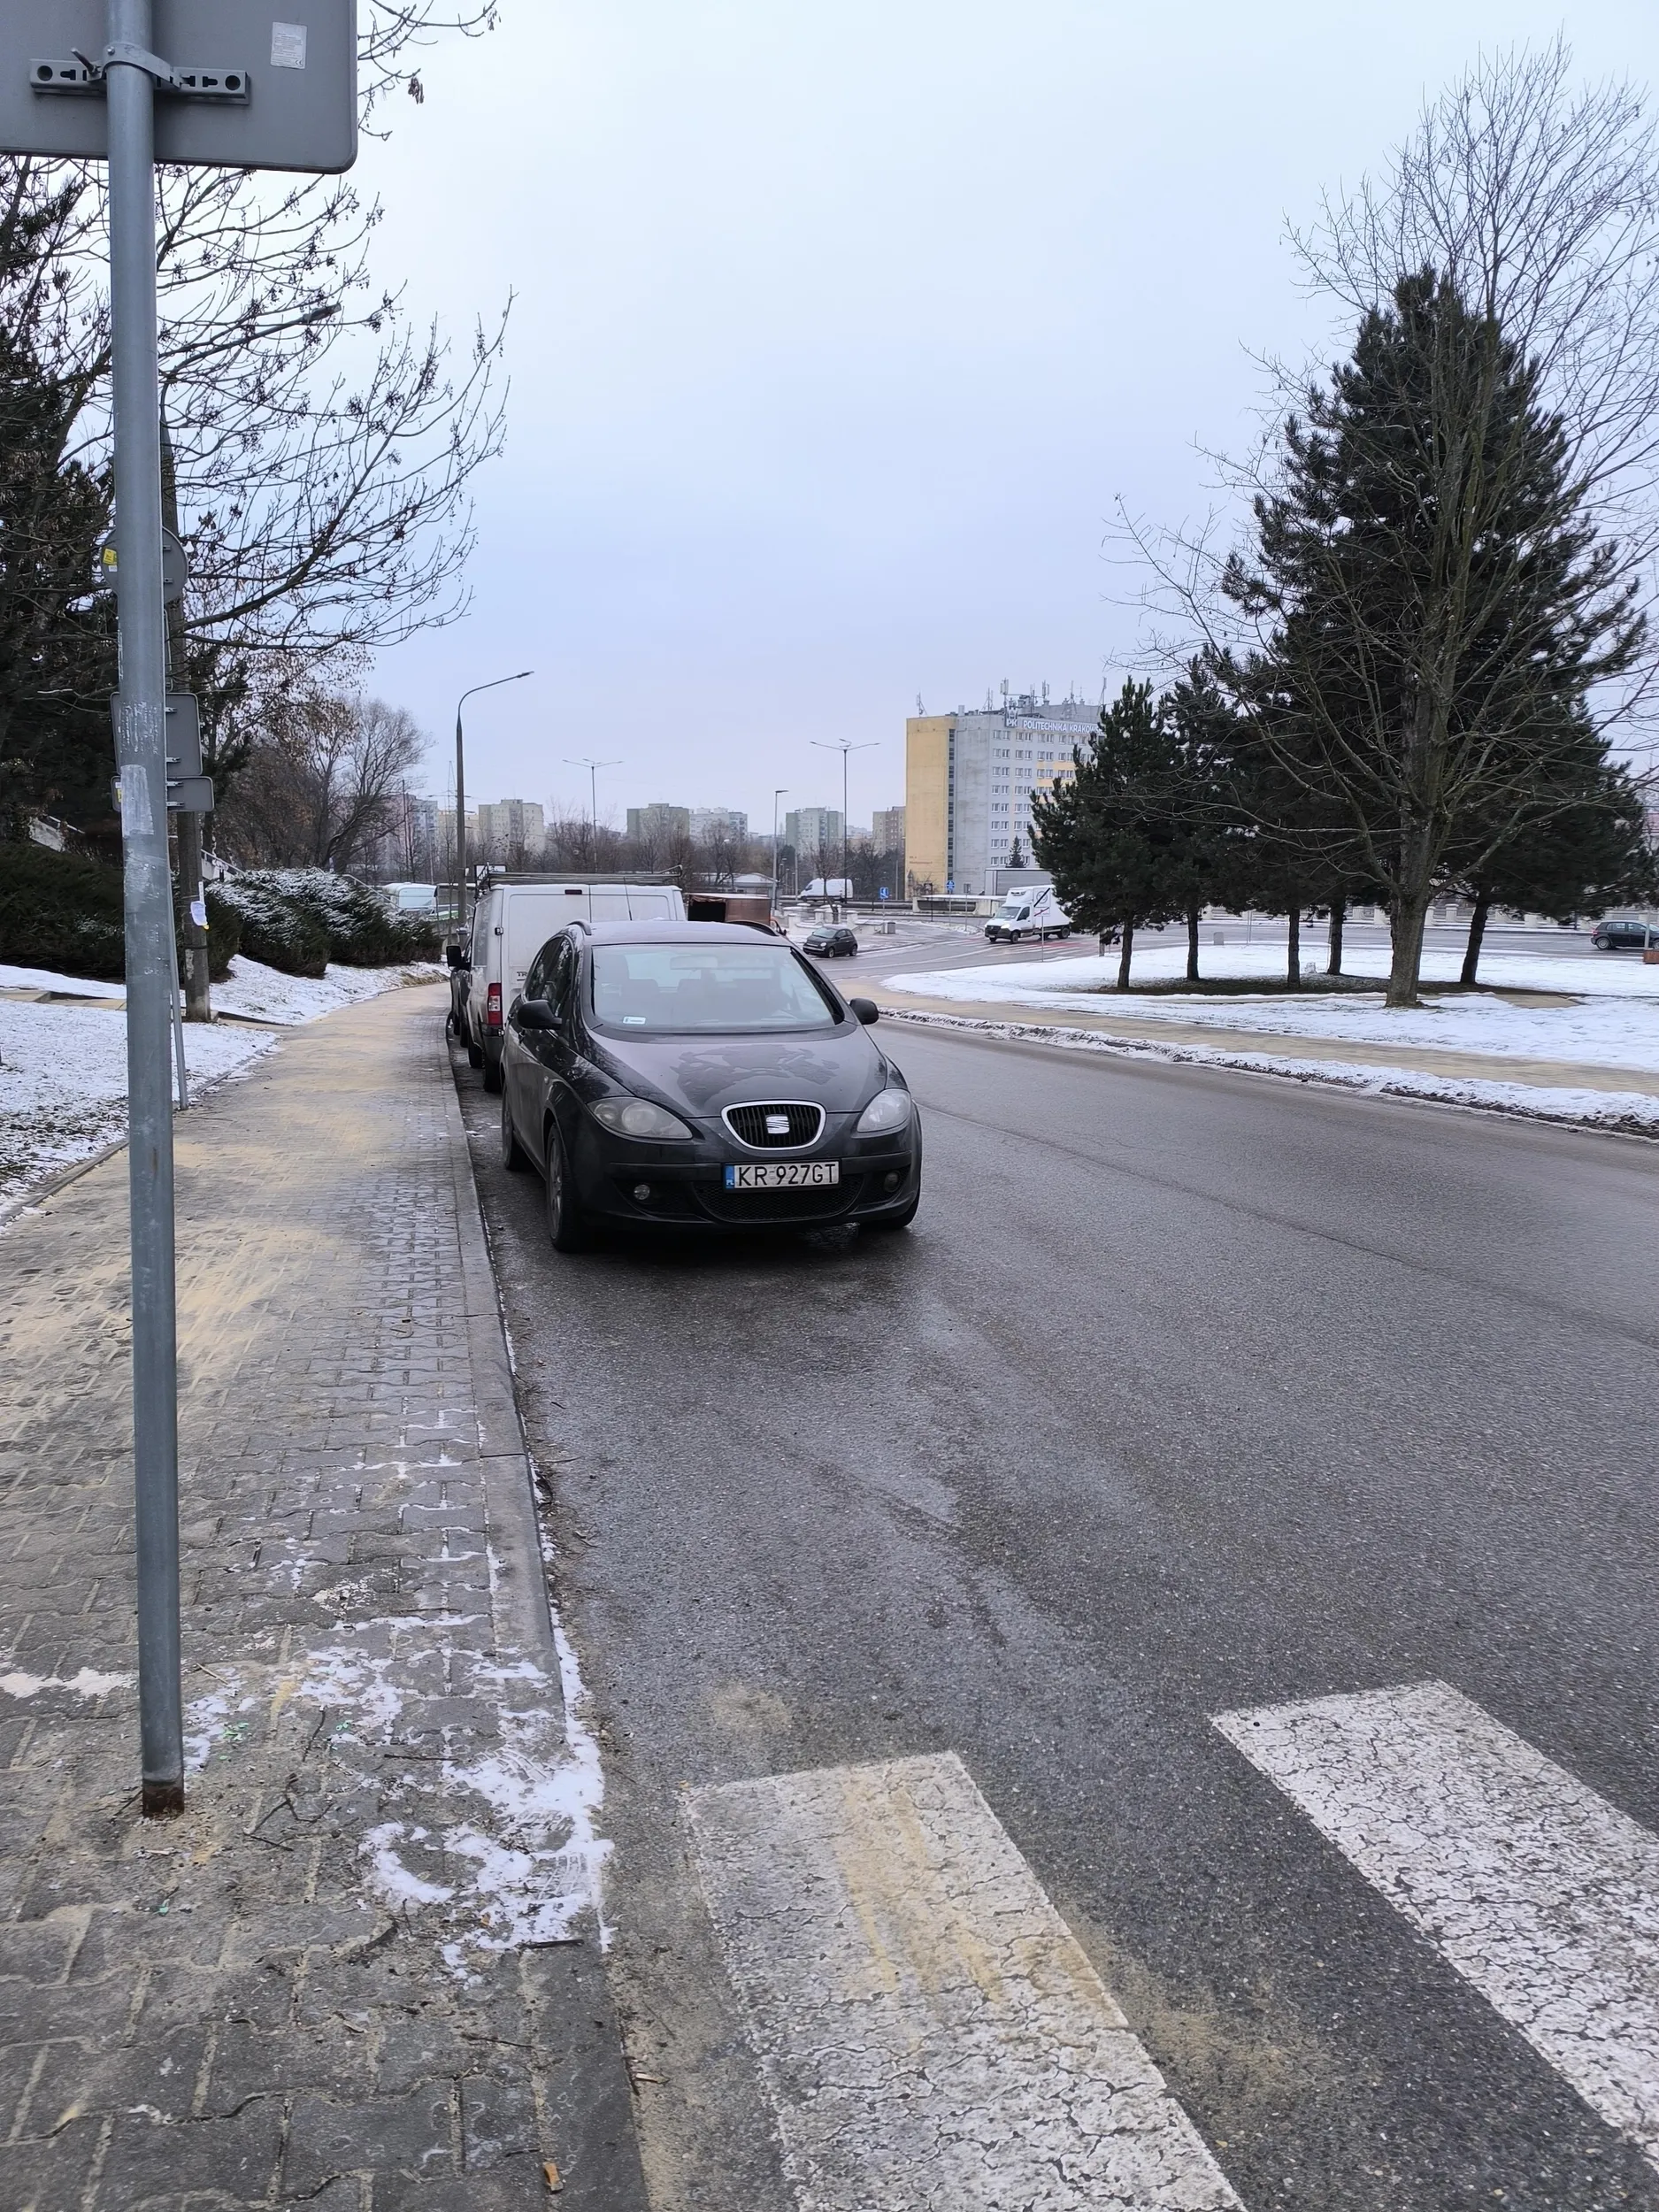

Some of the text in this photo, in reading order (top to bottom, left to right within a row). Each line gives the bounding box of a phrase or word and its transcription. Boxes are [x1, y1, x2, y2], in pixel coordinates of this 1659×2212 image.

[1023, 720, 1102, 734] POLITECHNIKA KRAKOWS
[739, 1164, 835, 1187] KR 927GT
